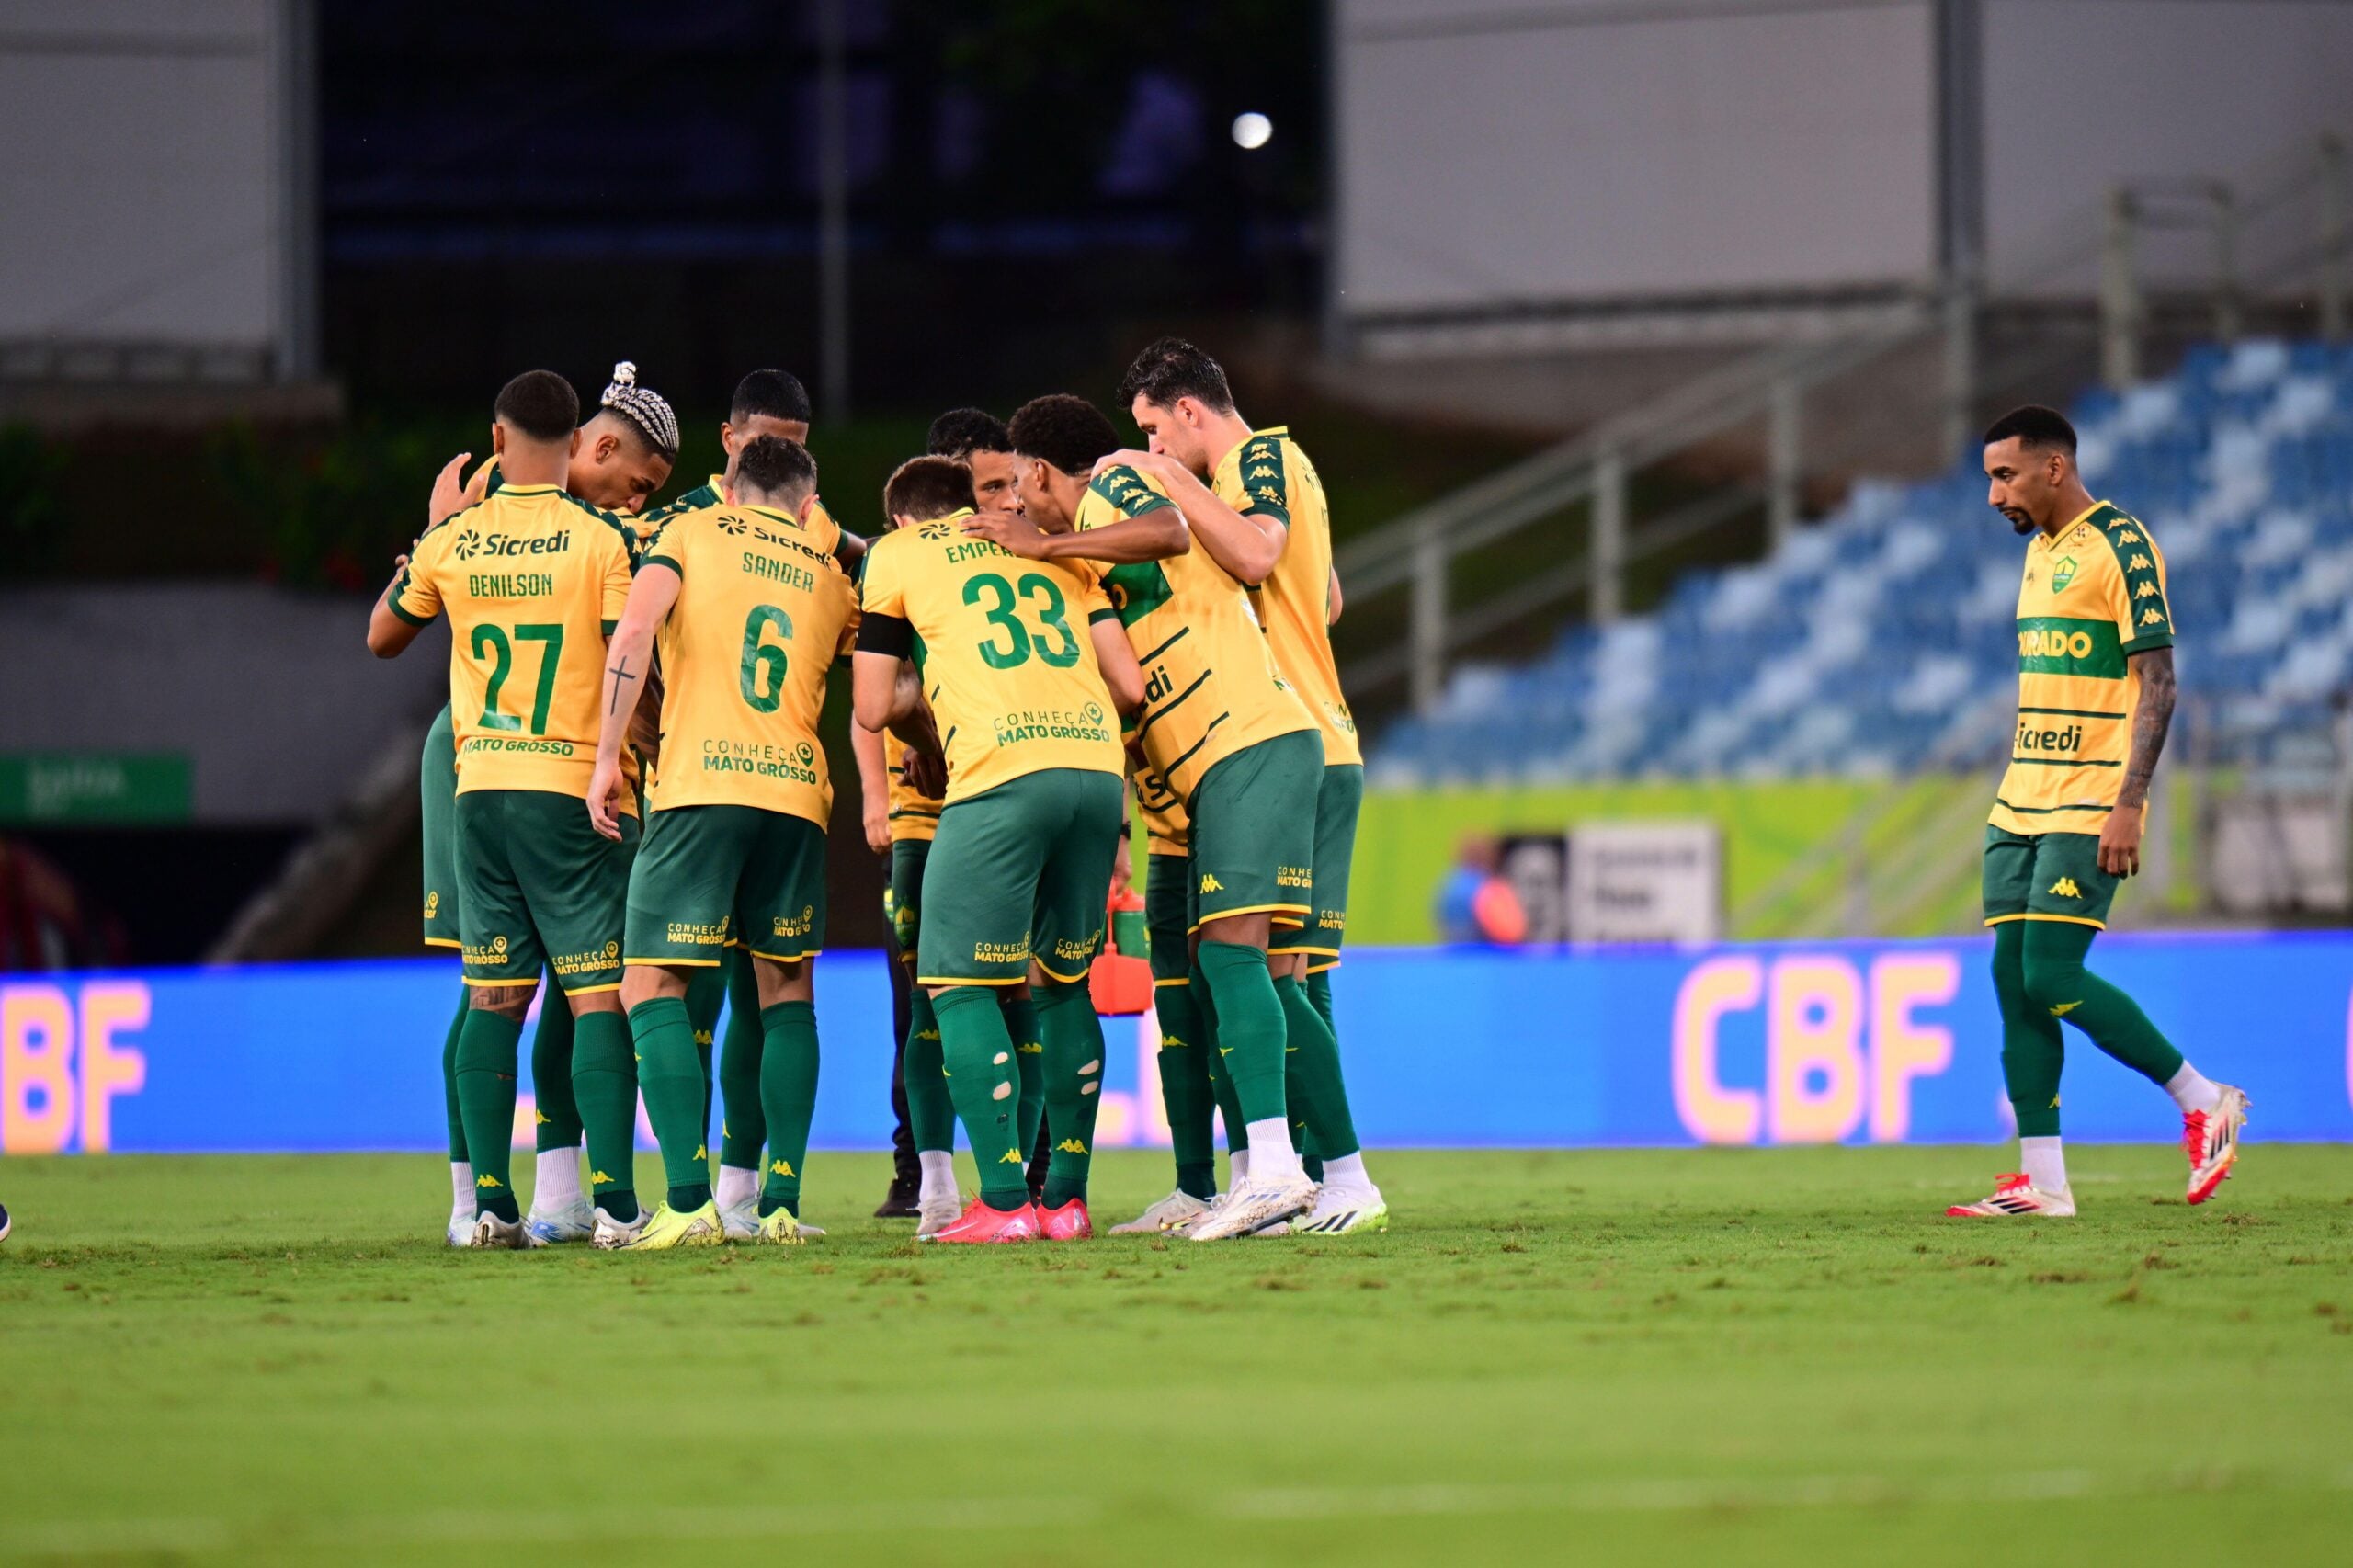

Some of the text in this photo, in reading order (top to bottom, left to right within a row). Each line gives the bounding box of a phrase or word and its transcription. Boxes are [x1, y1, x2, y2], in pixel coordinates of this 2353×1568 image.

[483, 530, 570, 556] Sicredi
[754, 527, 832, 571] Sicredi
[743, 551, 813, 593] SANDER
[470, 574, 553, 597] DENILSON
[962, 573, 1080, 669] 33
[740, 604, 793, 713] 6
[471, 623, 563, 735] 27
[993, 711, 1089, 731] CONHEÇA
[505, 740, 574, 756] GROSSO
[997, 725, 1110, 747] MATO GROSSO
[2015, 722, 2082, 752] icredi
[703, 740, 799, 765] CONHEÇA
[704, 756, 817, 785] MATO GROSSO
[1278, 867, 1312, 878] CONHE
[667, 933, 695, 943] MATO
[668, 923, 722, 935] CONHEÇA
[552, 950, 607, 966] CONHEÇA
[580, 959, 620, 972] GROSSO
[974, 951, 1005, 963] MATO
[1055, 947, 1082, 960] MATO
[1670, 953, 1961, 1144] CBF
[0, 980, 153, 1154] BF
